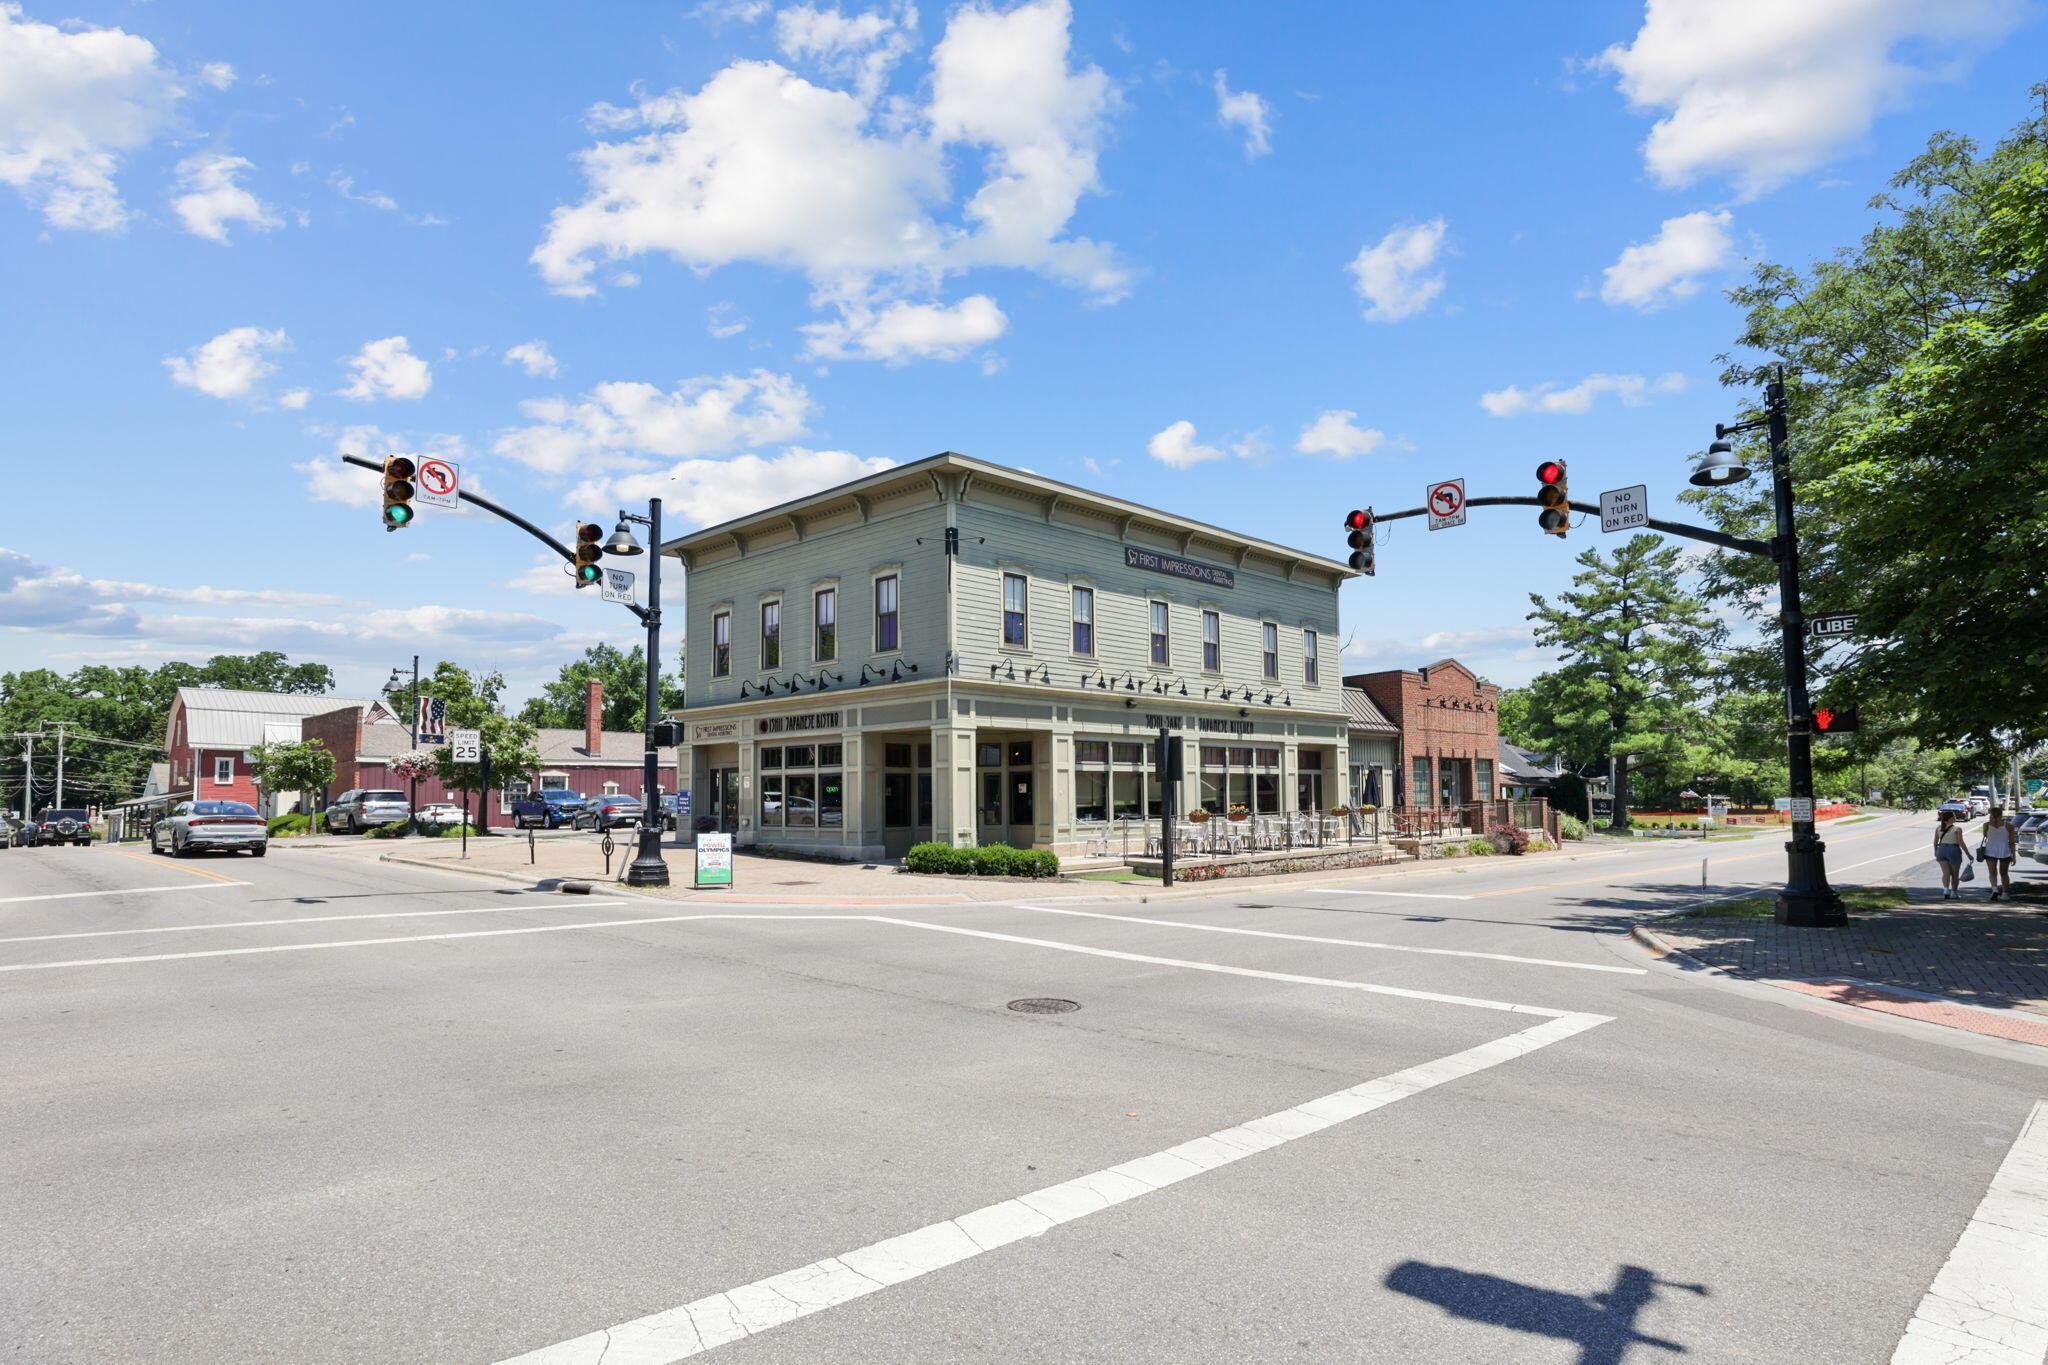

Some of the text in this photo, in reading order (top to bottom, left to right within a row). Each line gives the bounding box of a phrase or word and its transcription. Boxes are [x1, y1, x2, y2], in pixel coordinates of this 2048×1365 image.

[1615, 493, 1631, 503] NO
[1611, 503, 1637, 515] TURN
[1606, 513, 1643, 528] ON RED
[1139, 553, 1212, 580] FIRST IMPRESSIONS
[612, 574, 625, 582] NO
[609, 581, 629, 591] TURN
[605, 591, 632, 601] ON RED
[1817, 618, 1859, 634] LIBE
[768, 712, 839, 733] ISHII JAPANESE BISTRO
[1145, 714, 1163, 729] SUSHI
[1198, 717, 1254, 734] JAPANESE KITCHEN
[456, 746, 477, 759] 25
